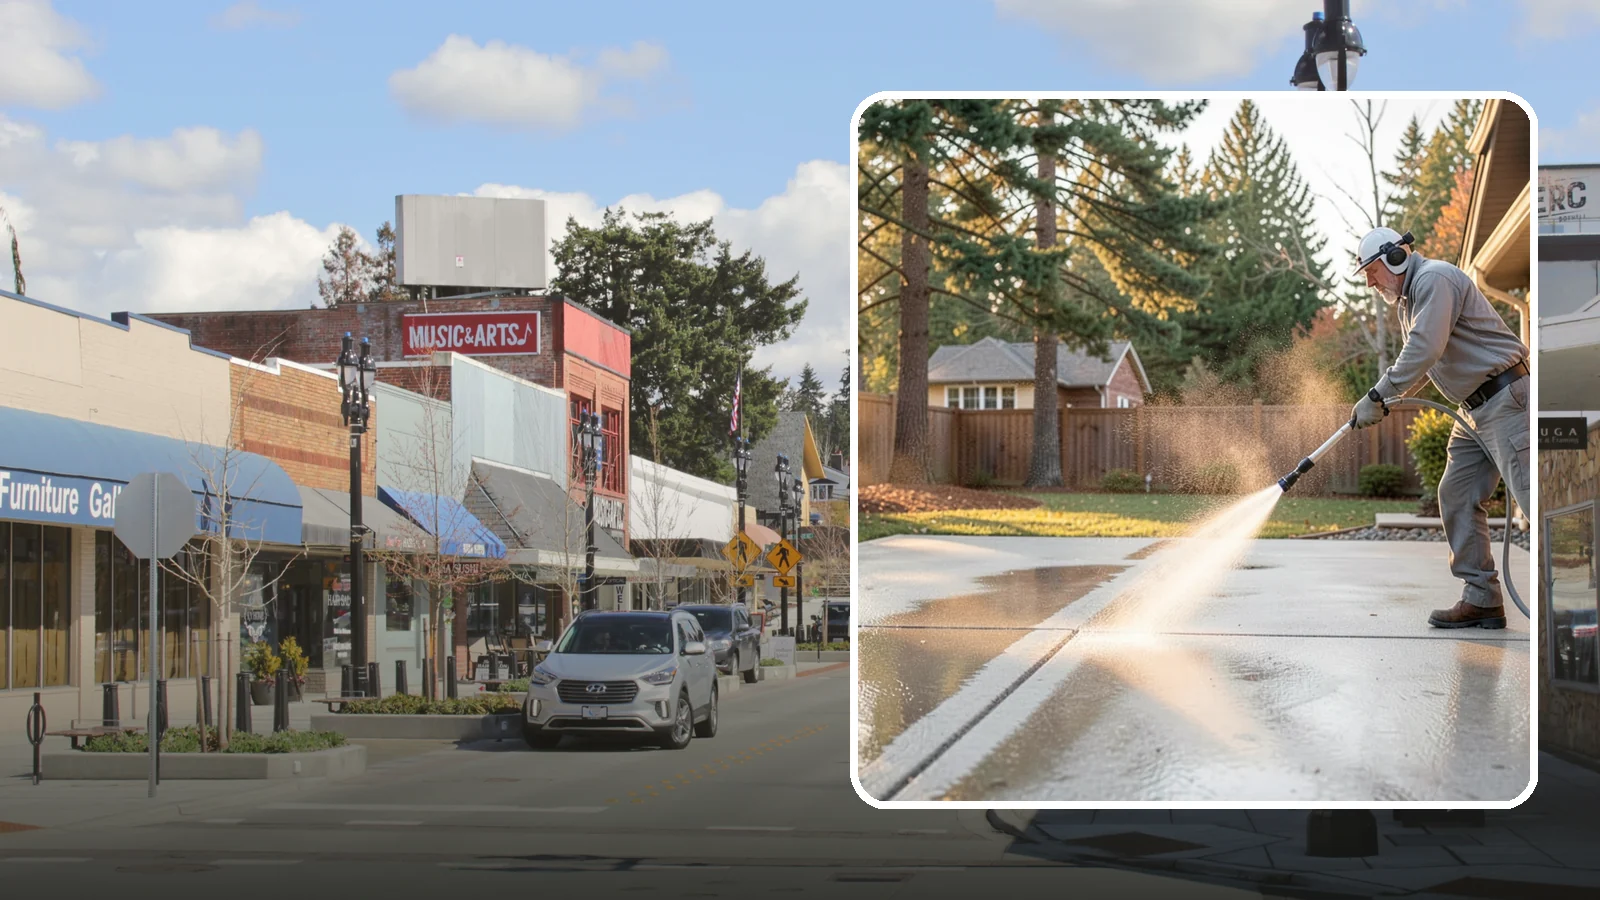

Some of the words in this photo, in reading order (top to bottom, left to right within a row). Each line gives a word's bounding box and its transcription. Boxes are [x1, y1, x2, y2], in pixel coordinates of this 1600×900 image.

[408, 323, 520, 349] MUSIC&ARTS
[0, 472, 79, 515] Furniture
[89, 482, 122, 519] Gal
[453, 563, 479, 575] SUSHI
